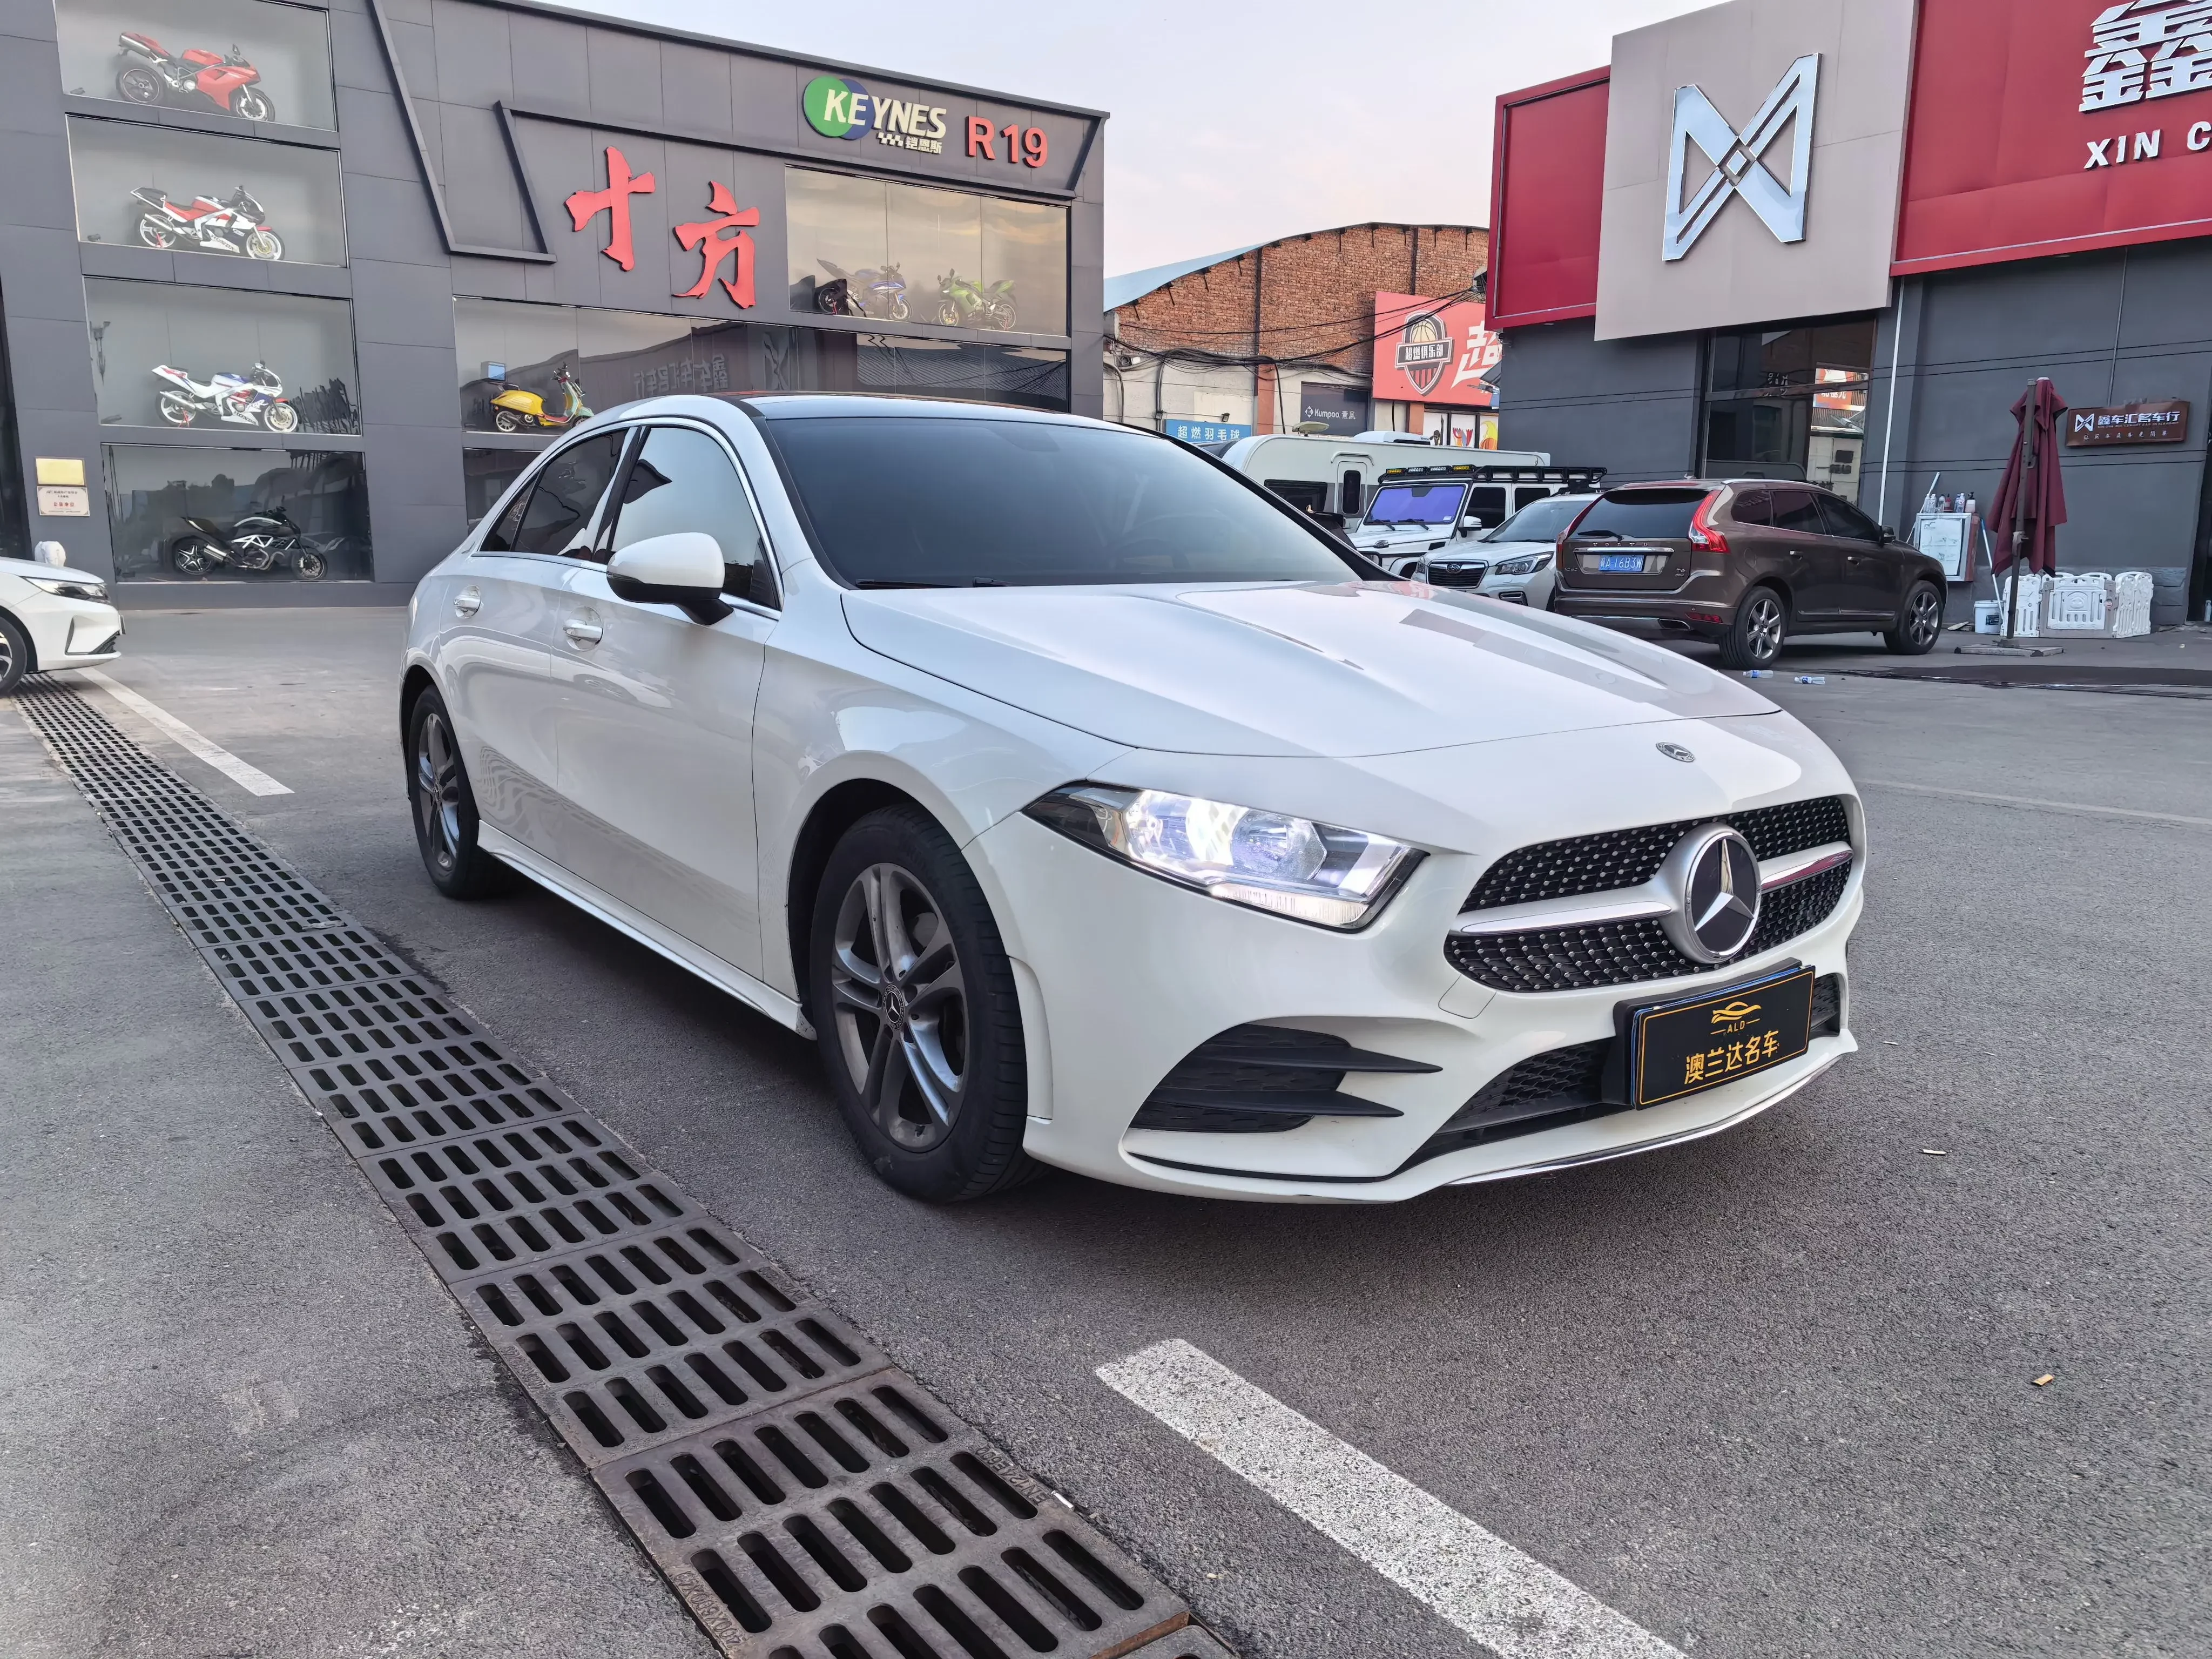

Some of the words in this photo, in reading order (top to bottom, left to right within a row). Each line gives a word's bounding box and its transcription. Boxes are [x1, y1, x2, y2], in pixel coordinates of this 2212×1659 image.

[824, 89, 947, 139] KEYNES
[965, 115, 1048, 168] R19
[905, 136, 942, 154] 铠恩斯
[2083, 129, 2161, 169] XIN
[563, 145, 760, 309] 十方
[1405, 344, 1444, 361] 超燃俱乐部
[1314, 408, 1340, 420] Kumpoo
[2098, 411, 2181, 426] 鑫车汇名车行
[1177, 425, 1240, 441] 超燃羽毛球
[1727, 1020, 1746, 1034] ALD
[1684, 1030, 1780, 1085] 澳兰达名车
